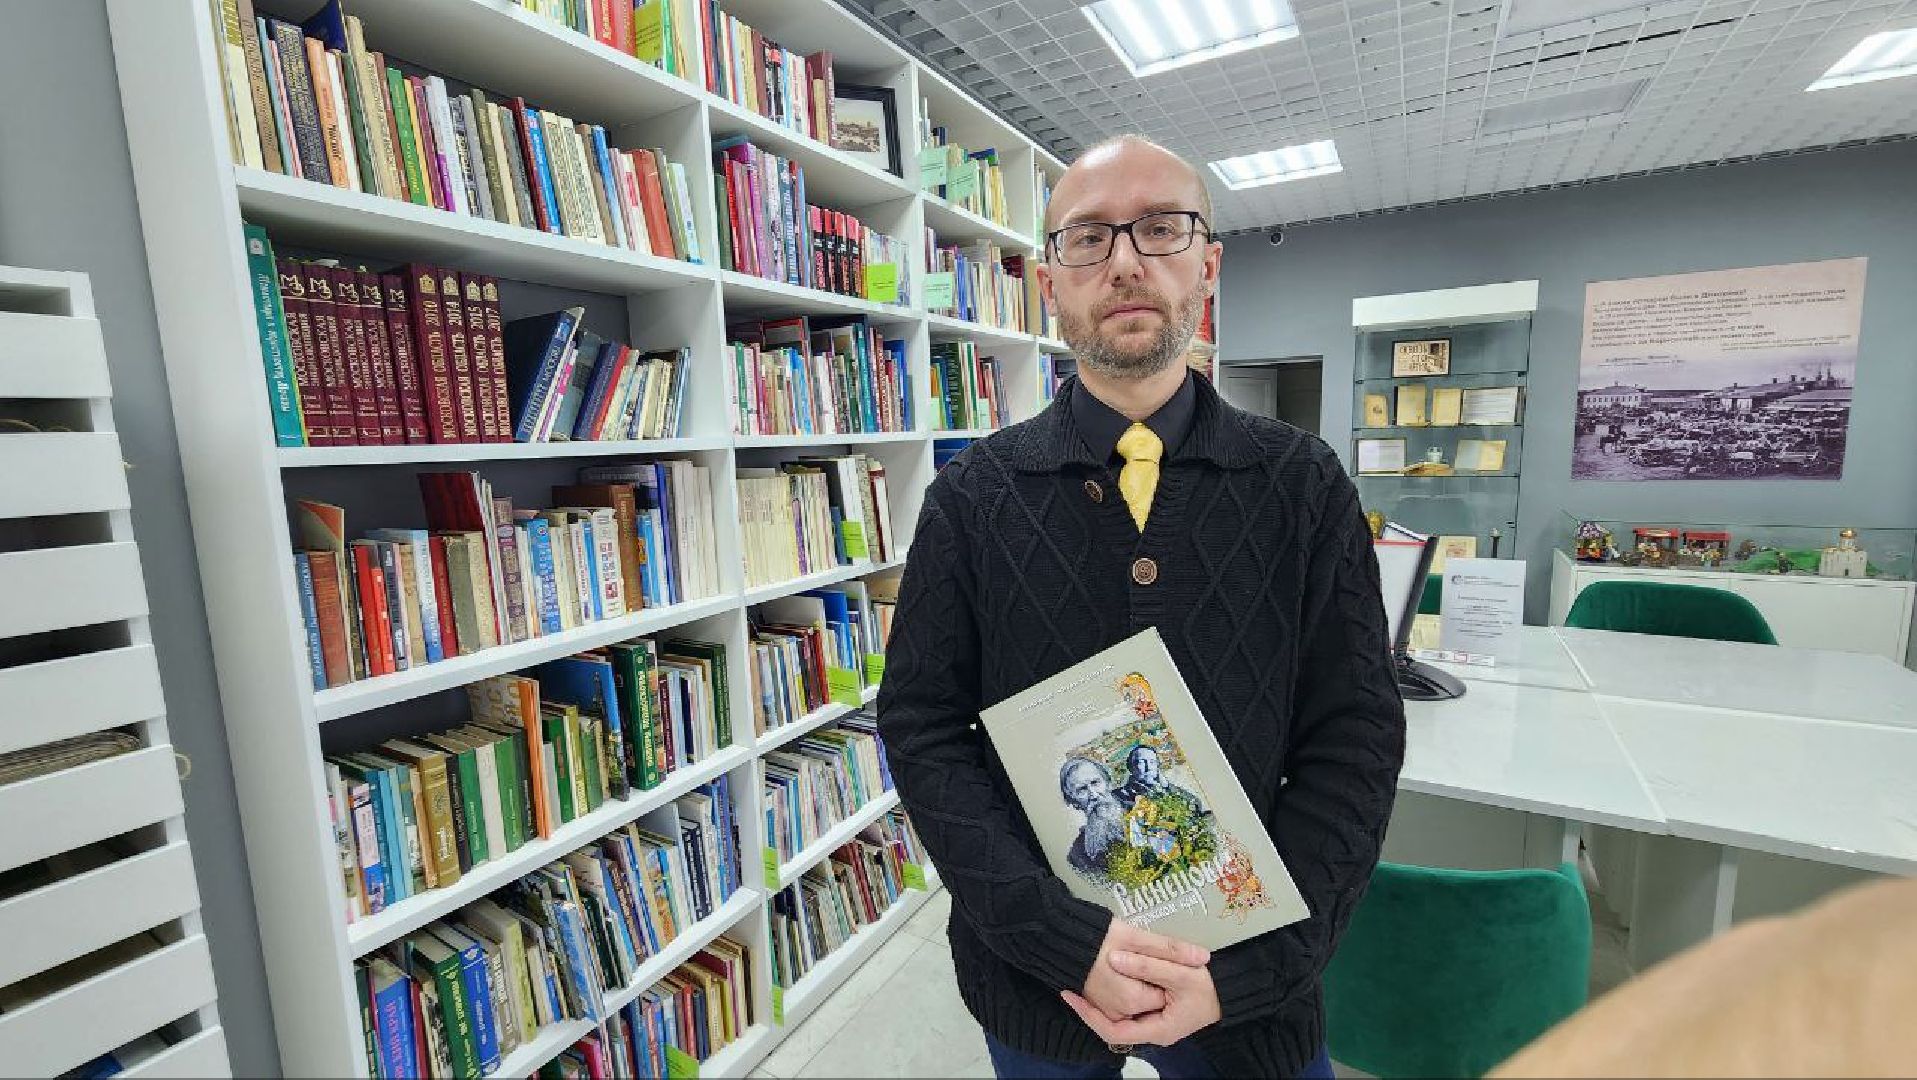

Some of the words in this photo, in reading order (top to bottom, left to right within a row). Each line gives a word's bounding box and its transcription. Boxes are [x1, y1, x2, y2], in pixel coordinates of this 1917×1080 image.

[428, 332, 446, 371] ОБЛАСТЬ
[451, 332, 468, 371] ОБЛАСТЬ
[472, 334, 489, 372] ОБЛАСТЬ
[490, 337, 504, 374] ОБЛАСТЬ
[434, 376, 456, 438] МОСКОВСКАЯ
[458, 376, 477, 436] МОСКОВСКАЯ
[478, 377, 497, 436] МОСКОВСКАЯ
[494, 378, 512, 436] МОСКОВСКАЯ
